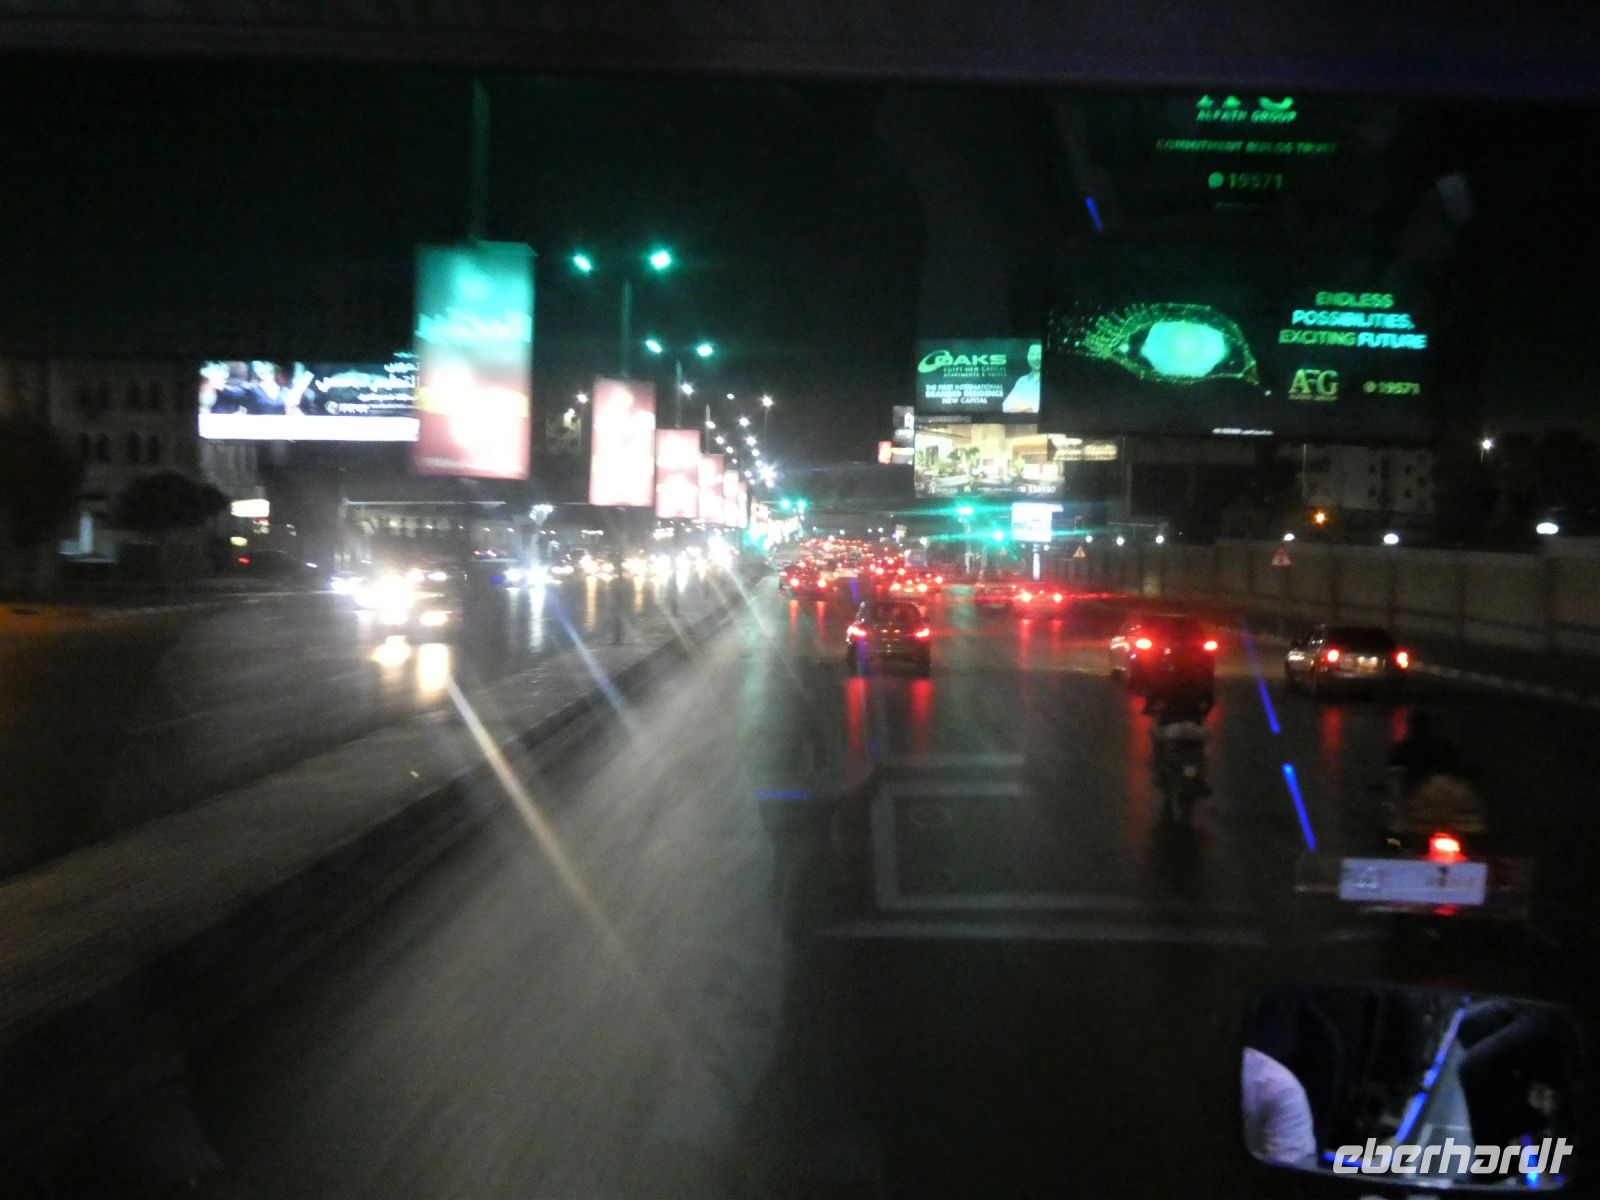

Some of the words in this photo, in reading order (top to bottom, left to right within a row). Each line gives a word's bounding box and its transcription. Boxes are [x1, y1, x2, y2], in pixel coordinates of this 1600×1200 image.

[1314, 291, 1395, 309] ENDLESS
[1278, 329, 1357, 347] EXCITING
[1356, 331, 1429, 350] FUTURE
[1287, 368, 1339, 396] AFG
[942, 397, 959, 405] NEW
[959, 397, 989, 405] CAPITAL
